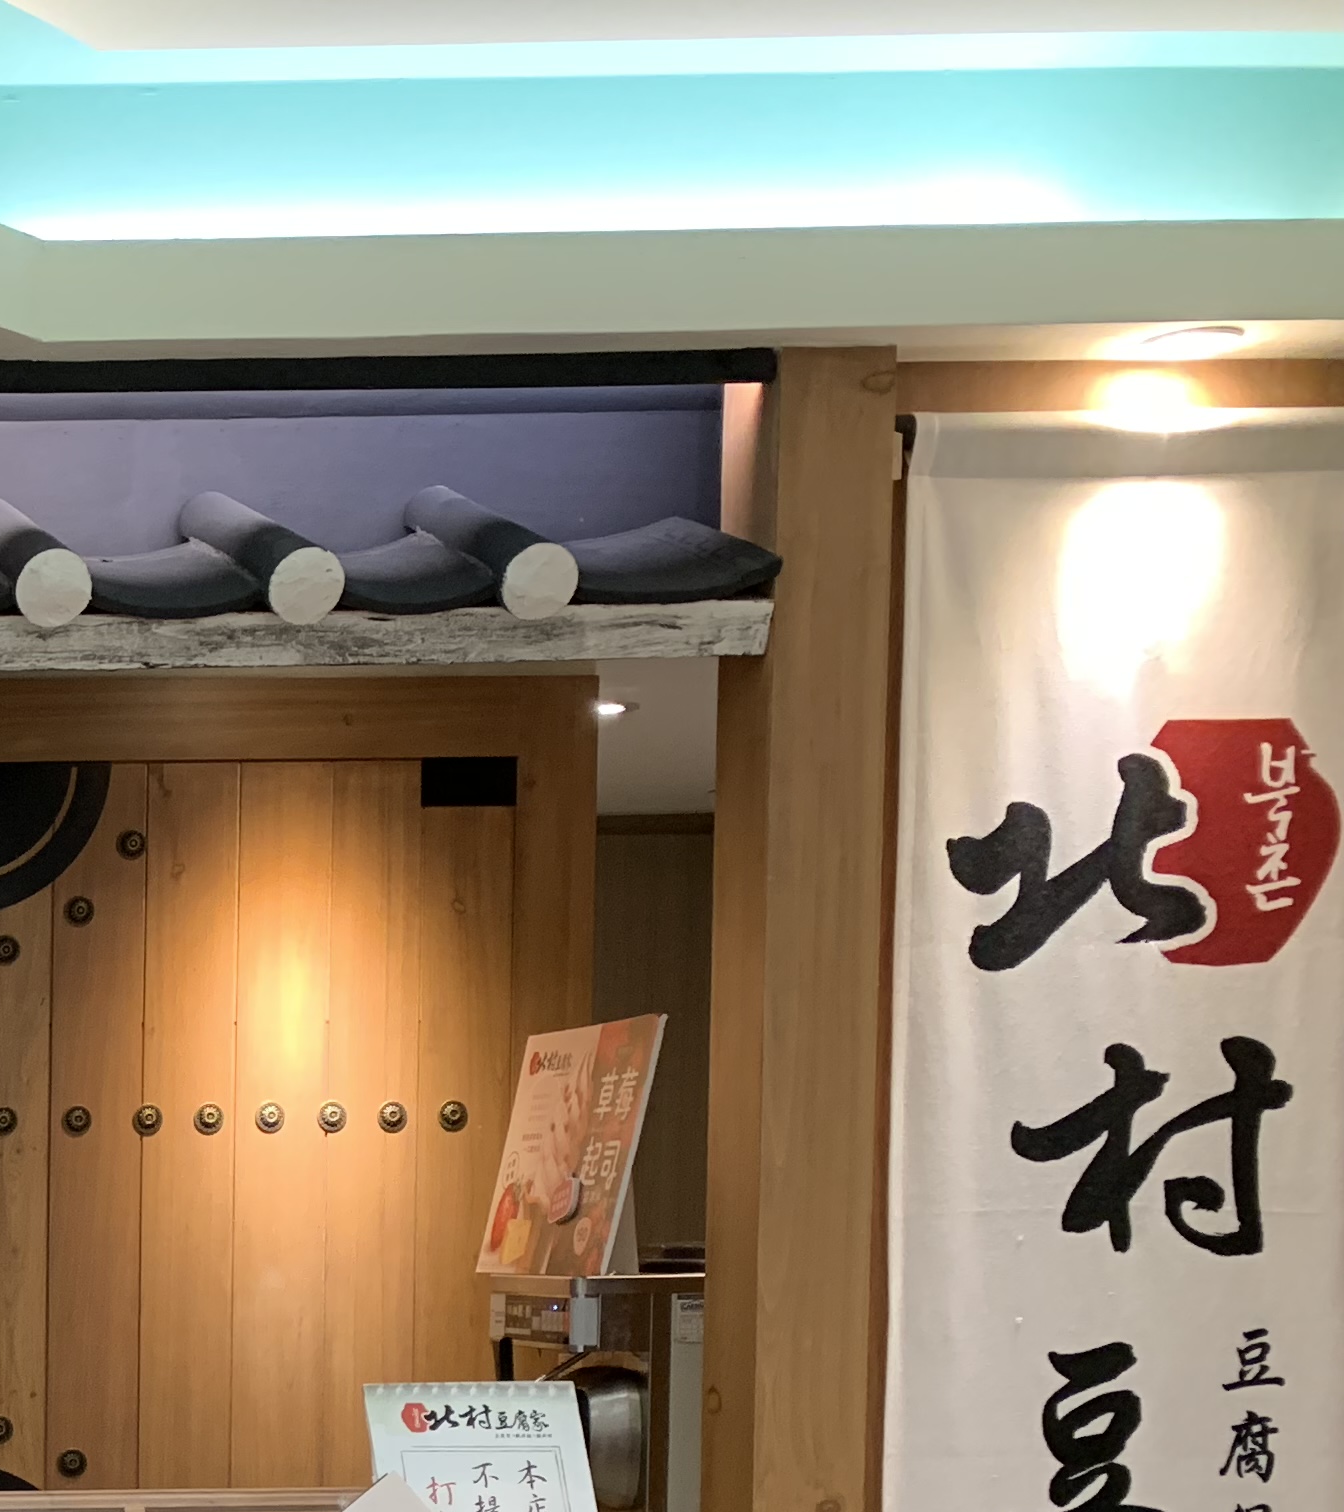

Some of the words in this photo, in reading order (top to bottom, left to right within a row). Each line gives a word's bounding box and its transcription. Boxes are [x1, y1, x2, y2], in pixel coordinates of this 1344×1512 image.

[593, 1066, 639, 1122] 草莓
[580, 1136, 621, 1191] 起司
[423, 1404, 550, 1432] 北村豆腐家
